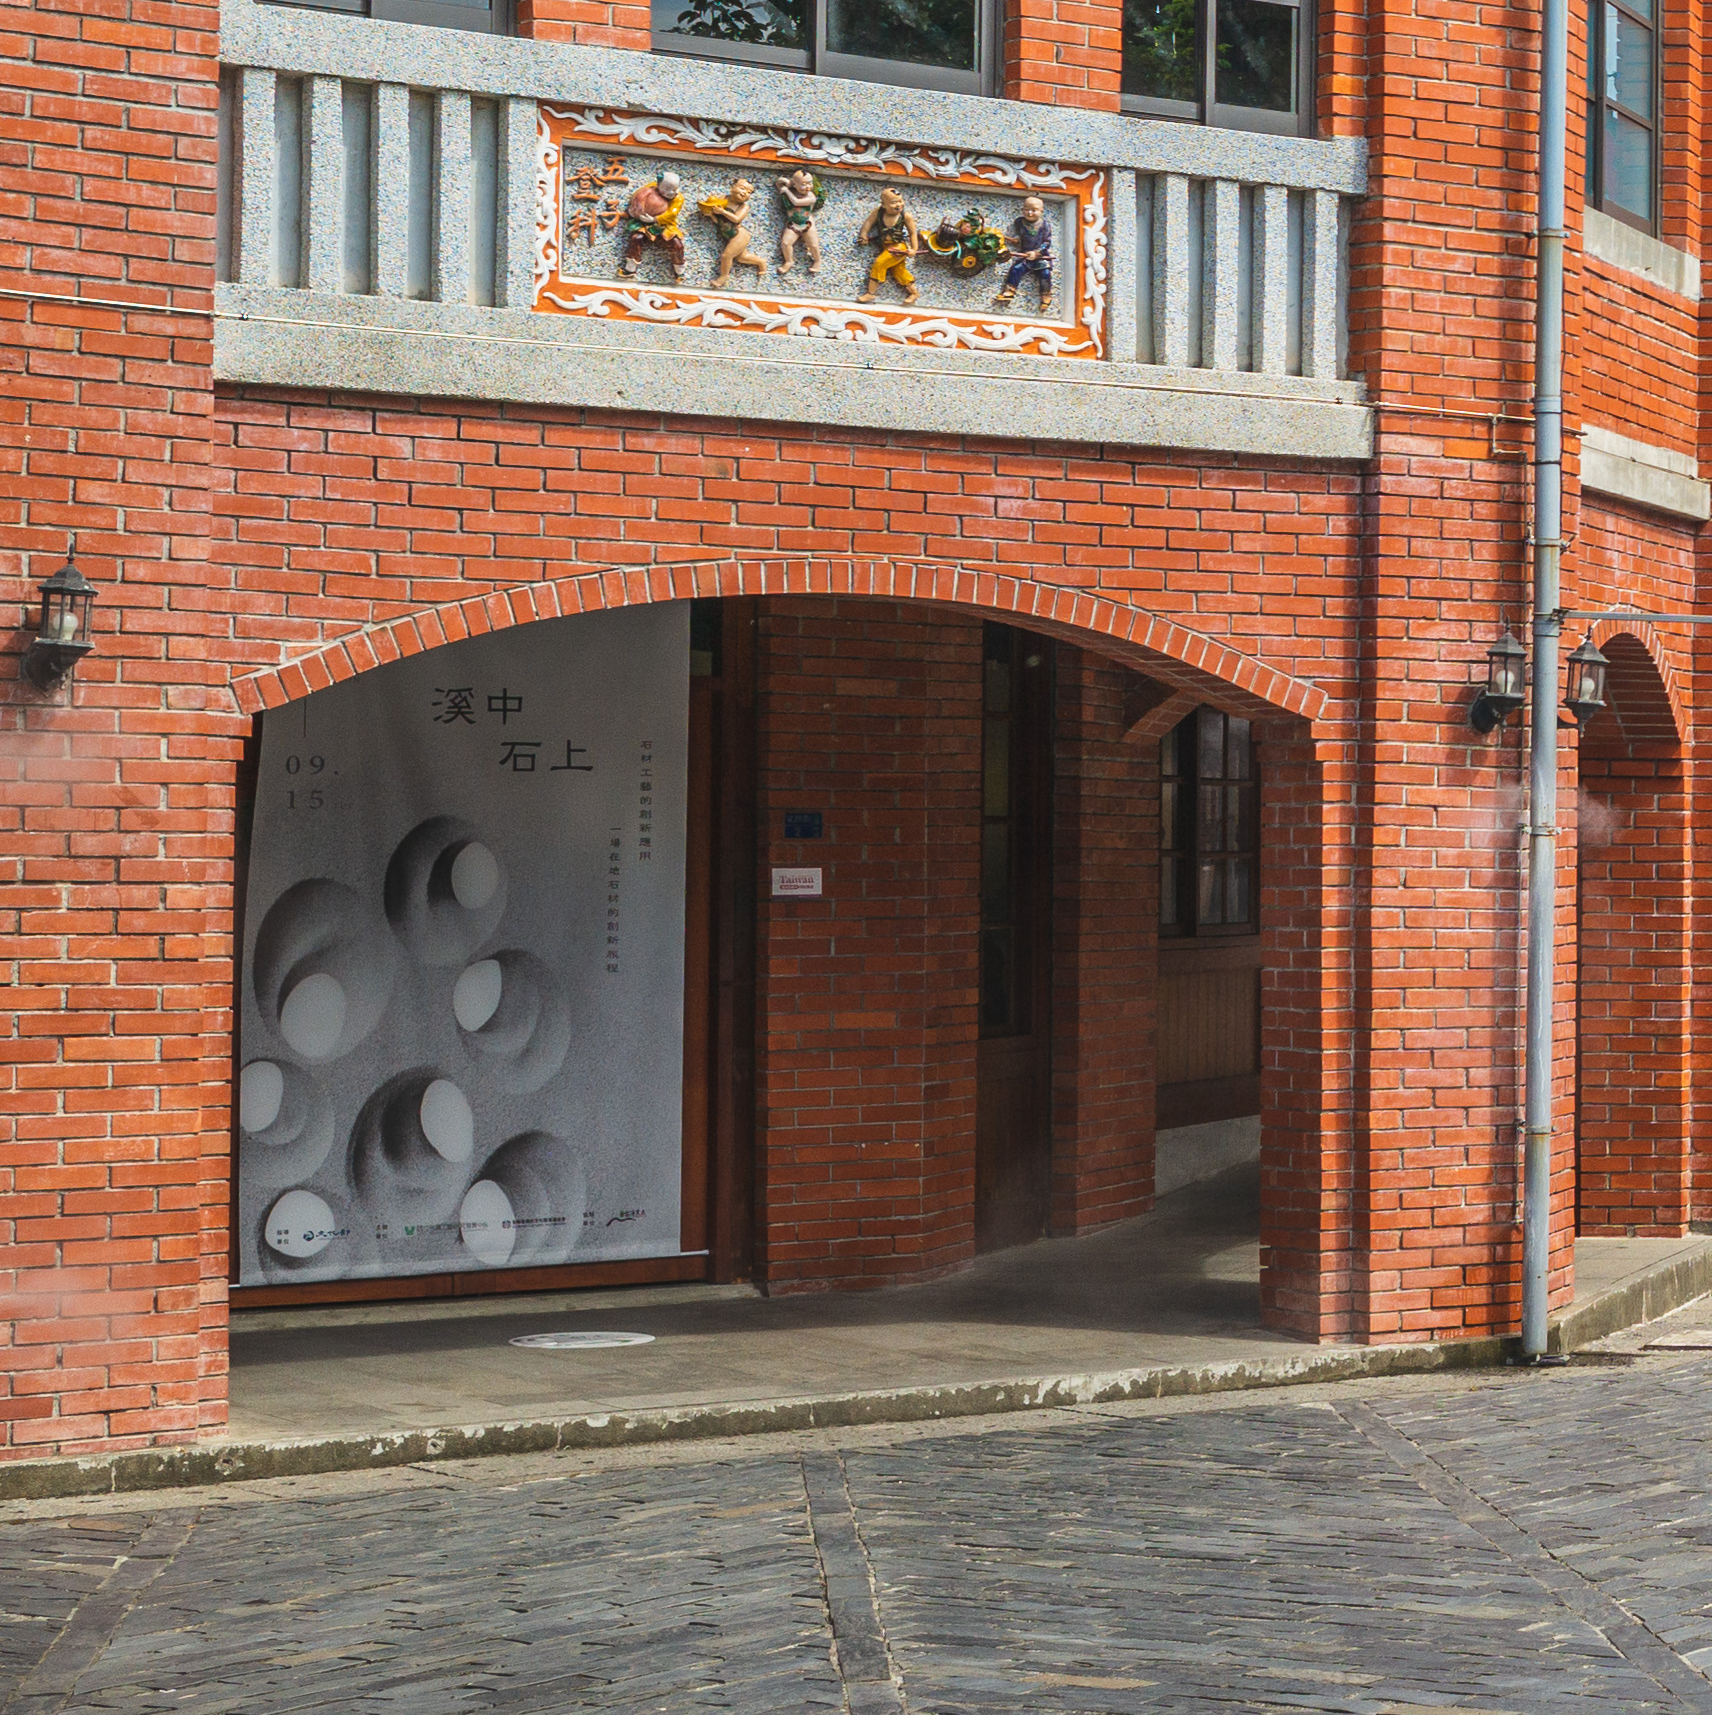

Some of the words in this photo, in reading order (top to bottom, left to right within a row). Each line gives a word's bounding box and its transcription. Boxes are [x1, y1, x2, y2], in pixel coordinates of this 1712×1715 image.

[565, 166, 605, 245] 登科
[600, 156, 629, 229] 五子
[432, 687, 524, 725] 溪中
[499, 739, 594, 773] 石上
[286, 789, 324, 810] 15
[780, 875, 815, 884] Taiwan
